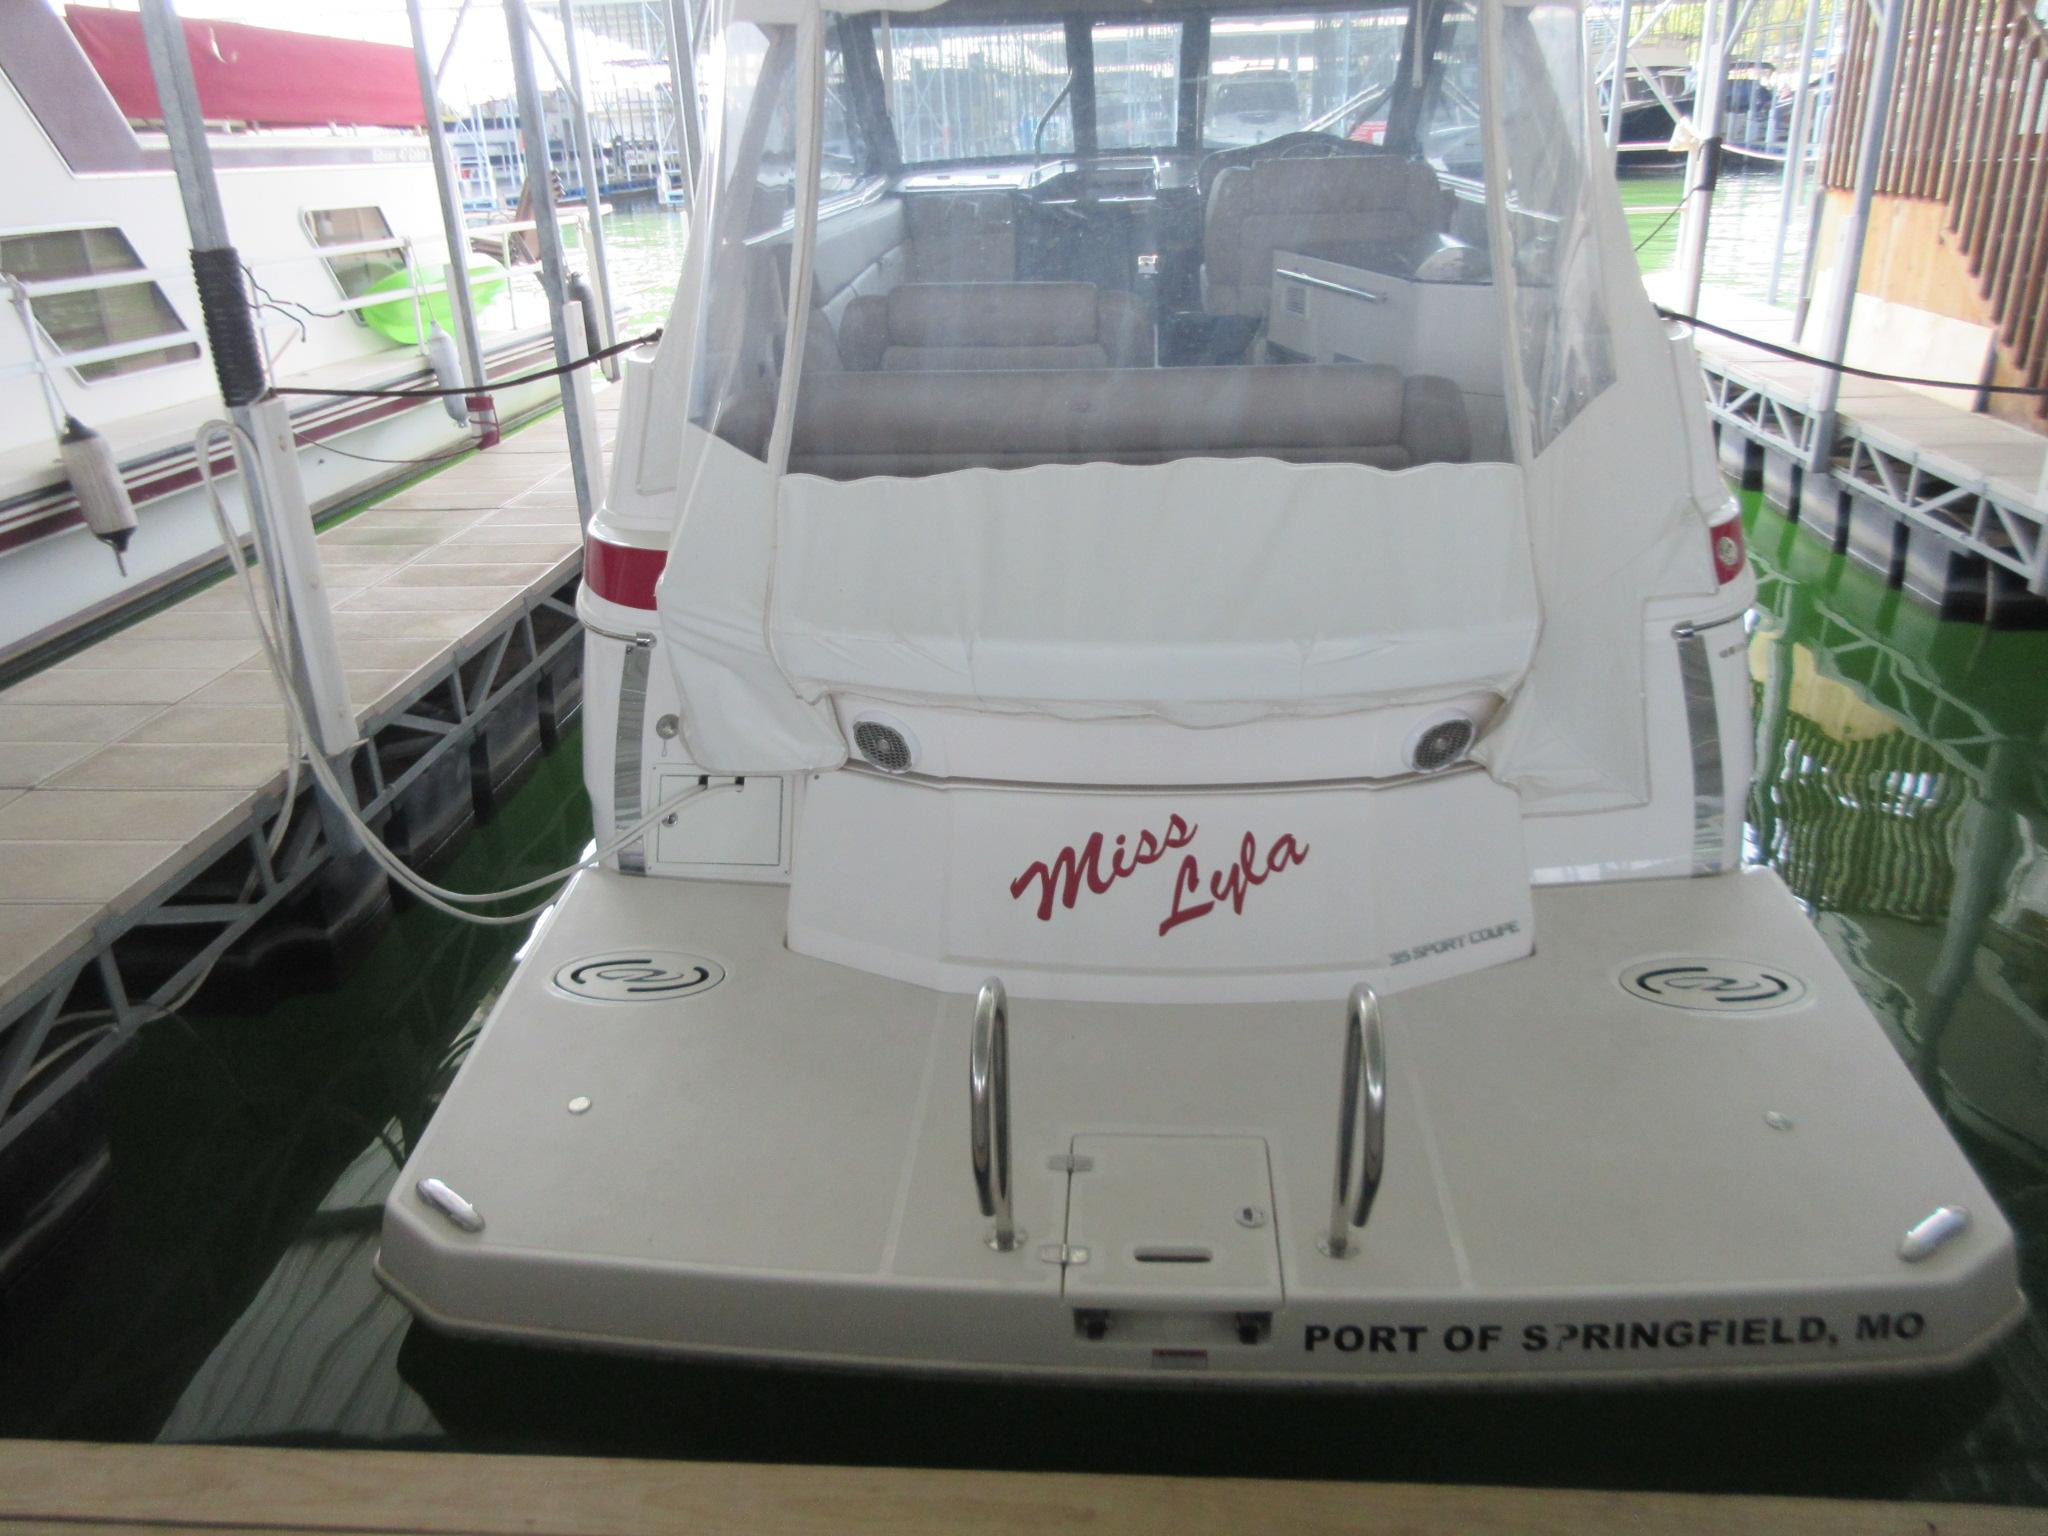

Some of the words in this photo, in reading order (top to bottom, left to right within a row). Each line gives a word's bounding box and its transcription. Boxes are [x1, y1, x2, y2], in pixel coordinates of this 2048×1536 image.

[1010, 813, 1198, 921] Miss
[1159, 831, 1310, 936] Lyla
[1412, 934, 1467, 960] SPORT
[1468, 920, 1520, 944] COUPE
[1304, 1325, 1427, 1352] PORT
[1443, 1325, 1503, 1352] OF
[1854, 1311, 1925, 1341] MO
